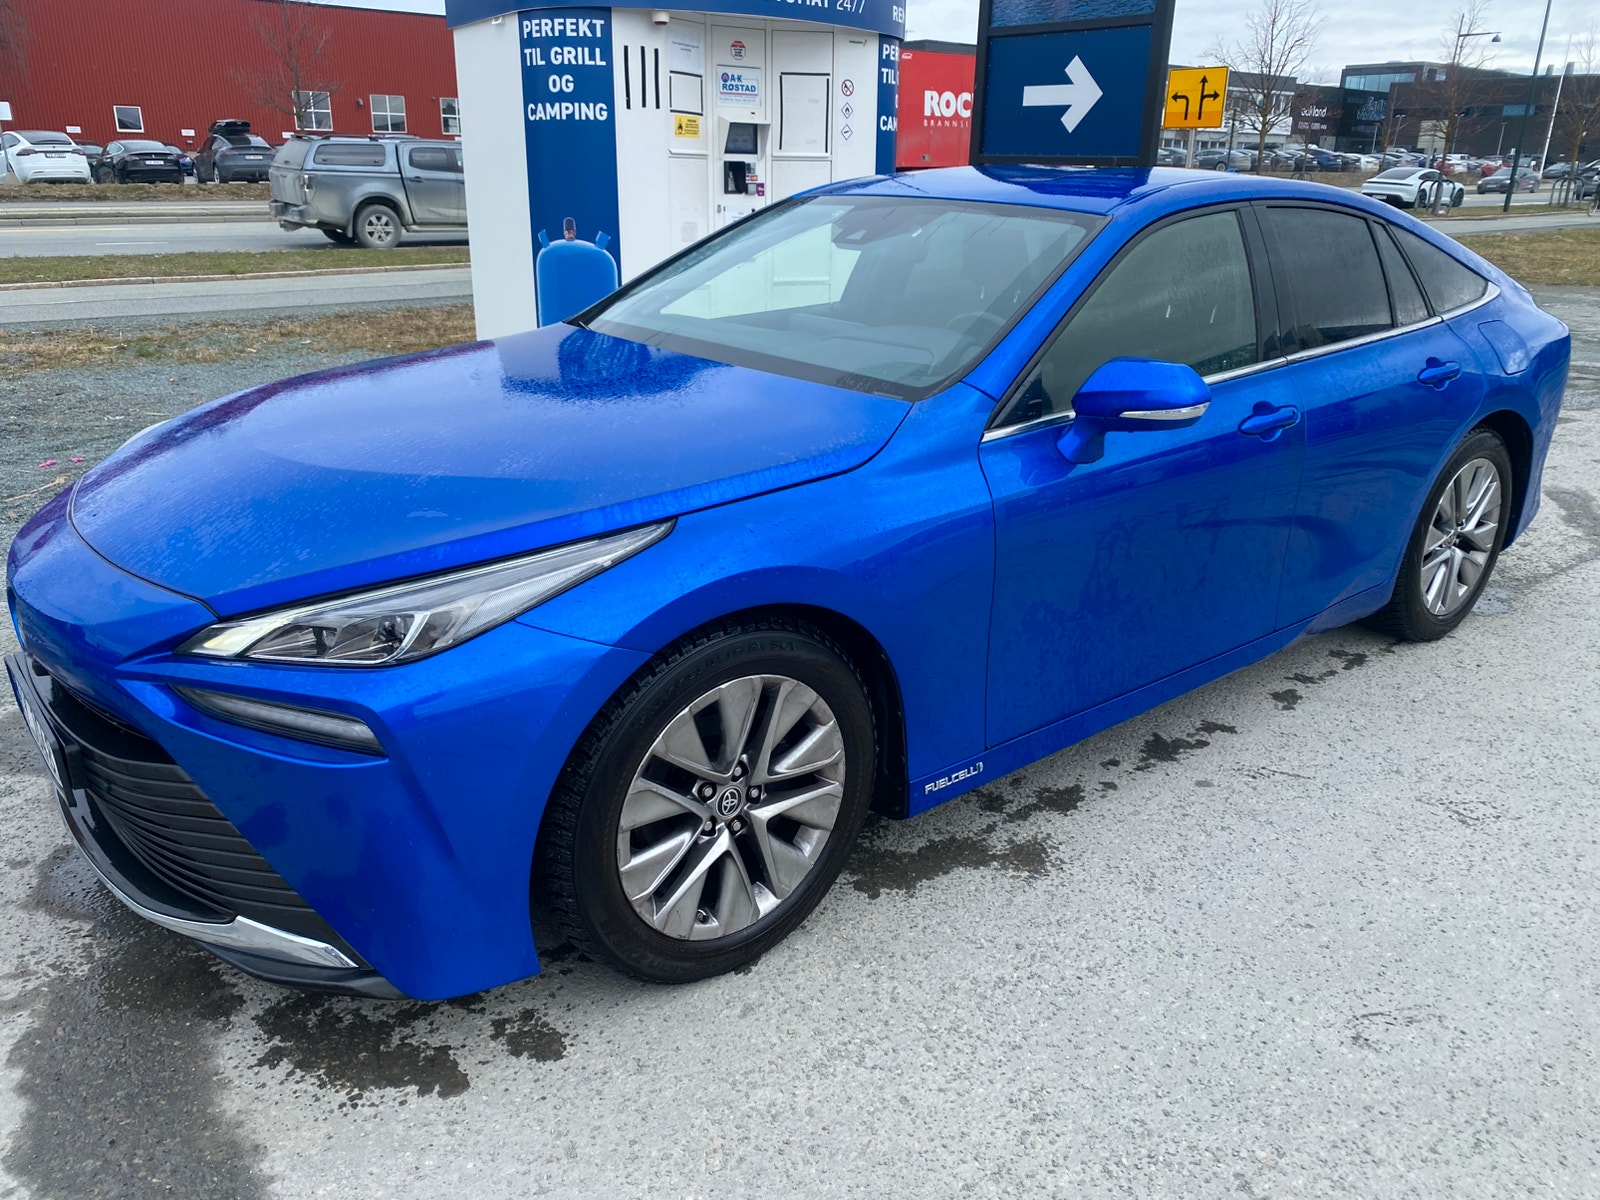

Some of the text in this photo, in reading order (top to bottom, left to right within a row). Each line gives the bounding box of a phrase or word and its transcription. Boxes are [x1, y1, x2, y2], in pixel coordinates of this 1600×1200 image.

[523, 18, 605, 38] PERFEKT
[524, 47, 607, 66] TIL GRILL
[548, 74, 574, 93] OG
[881, 67, 896, 84] TIL
[527, 102, 608, 121] CAMPING
[924, 90, 974, 118] ROC
[925, 766, 978, 795] FUELCELL
